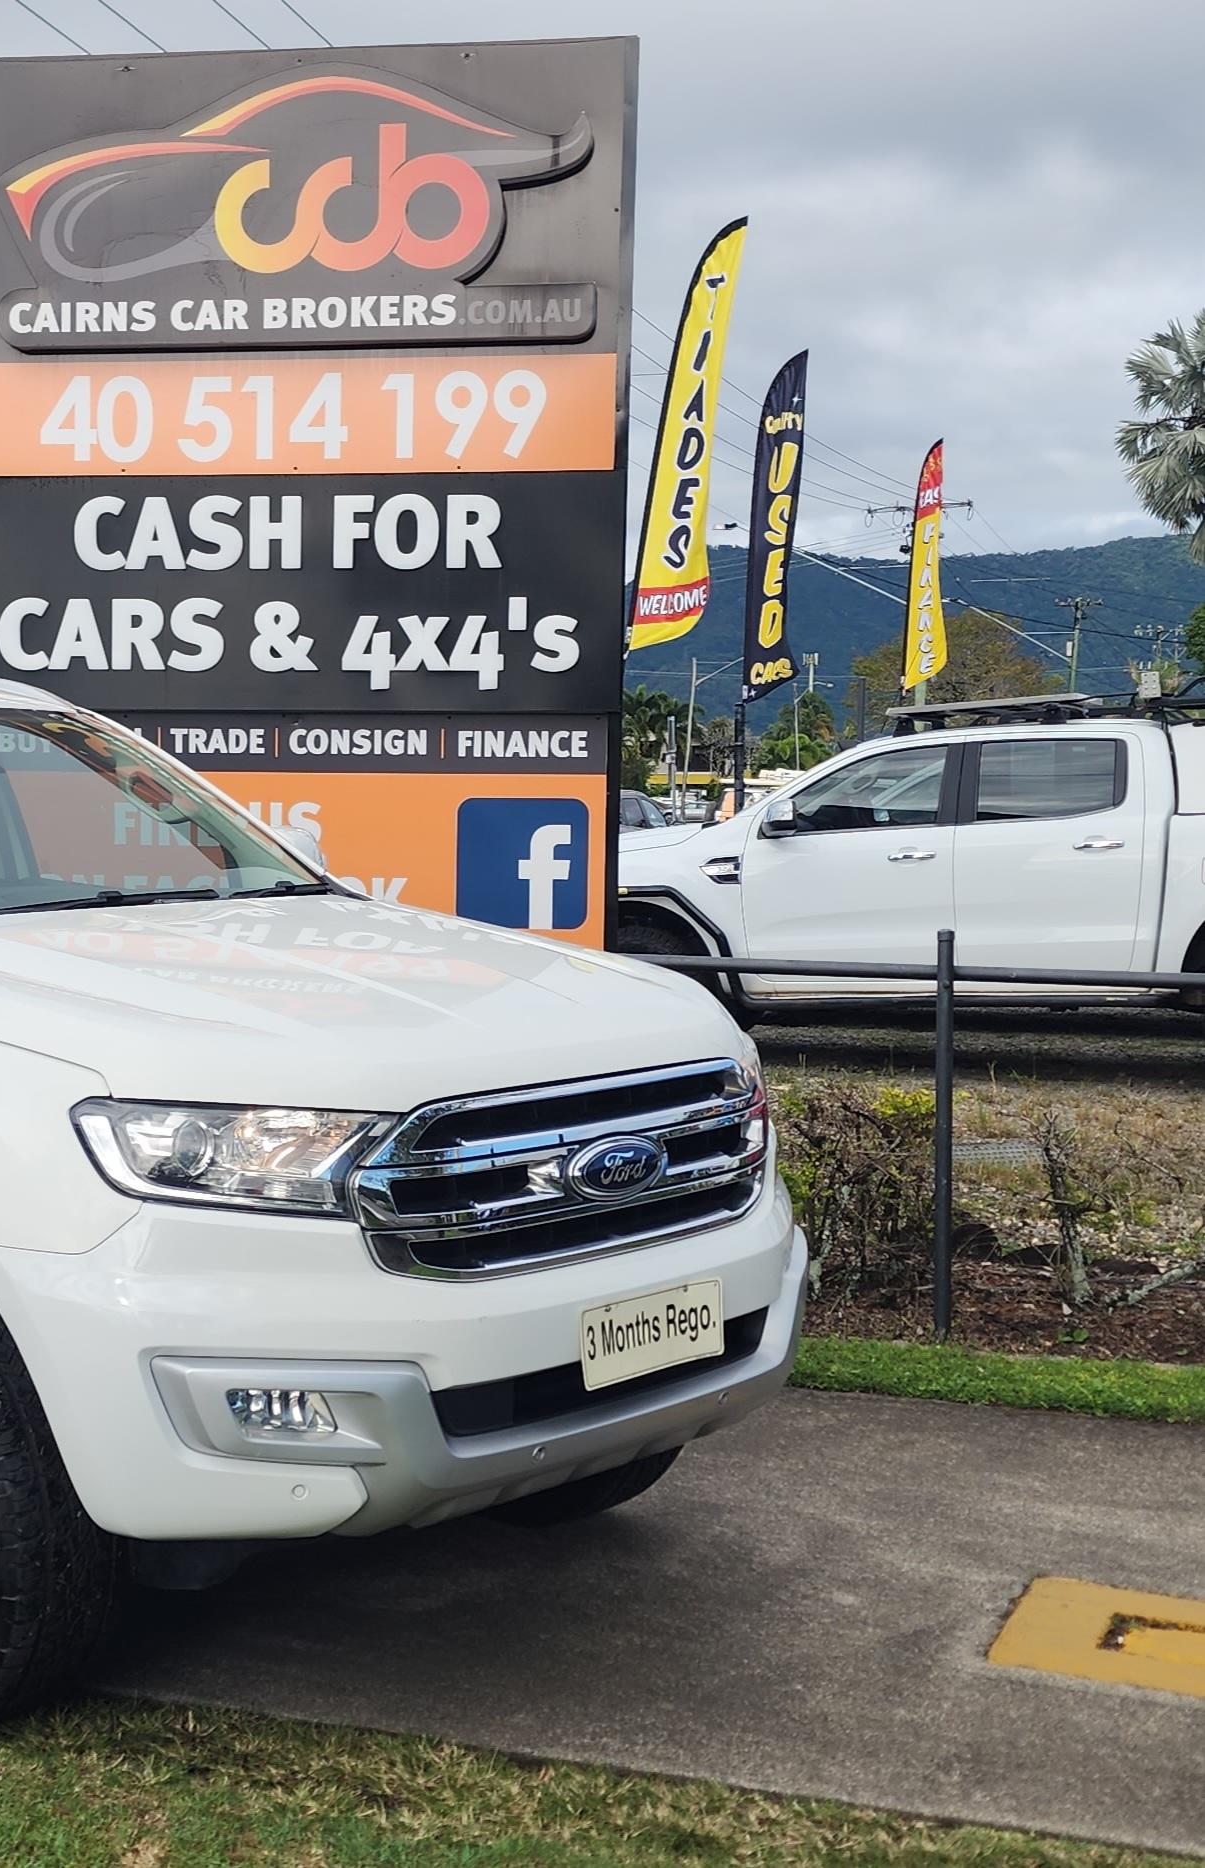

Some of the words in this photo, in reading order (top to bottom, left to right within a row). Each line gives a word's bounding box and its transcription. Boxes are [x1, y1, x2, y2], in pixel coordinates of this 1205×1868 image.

[8, 300, 156, 334] CAIRNS
[170, 299, 249, 332] CAR
[39, 374, 155, 464] 40
[177, 371, 349, 463] 514
[381, 367, 548, 460] 199
[73, 494, 302, 571] CASH
[332, 493, 502, 570] FOR
[249, 600, 319, 673] &
[170, 727, 266, 755] TRADE
[288, 728, 428, 756] CONSIGN
[457, 730, 589, 758] FINANCE
[600, 1150, 647, 1184] Ford
[586, 1325, 597, 1361] 3
[600, 1311, 661, 1356] Months
[666, 1303, 716, 1342] Rego.
